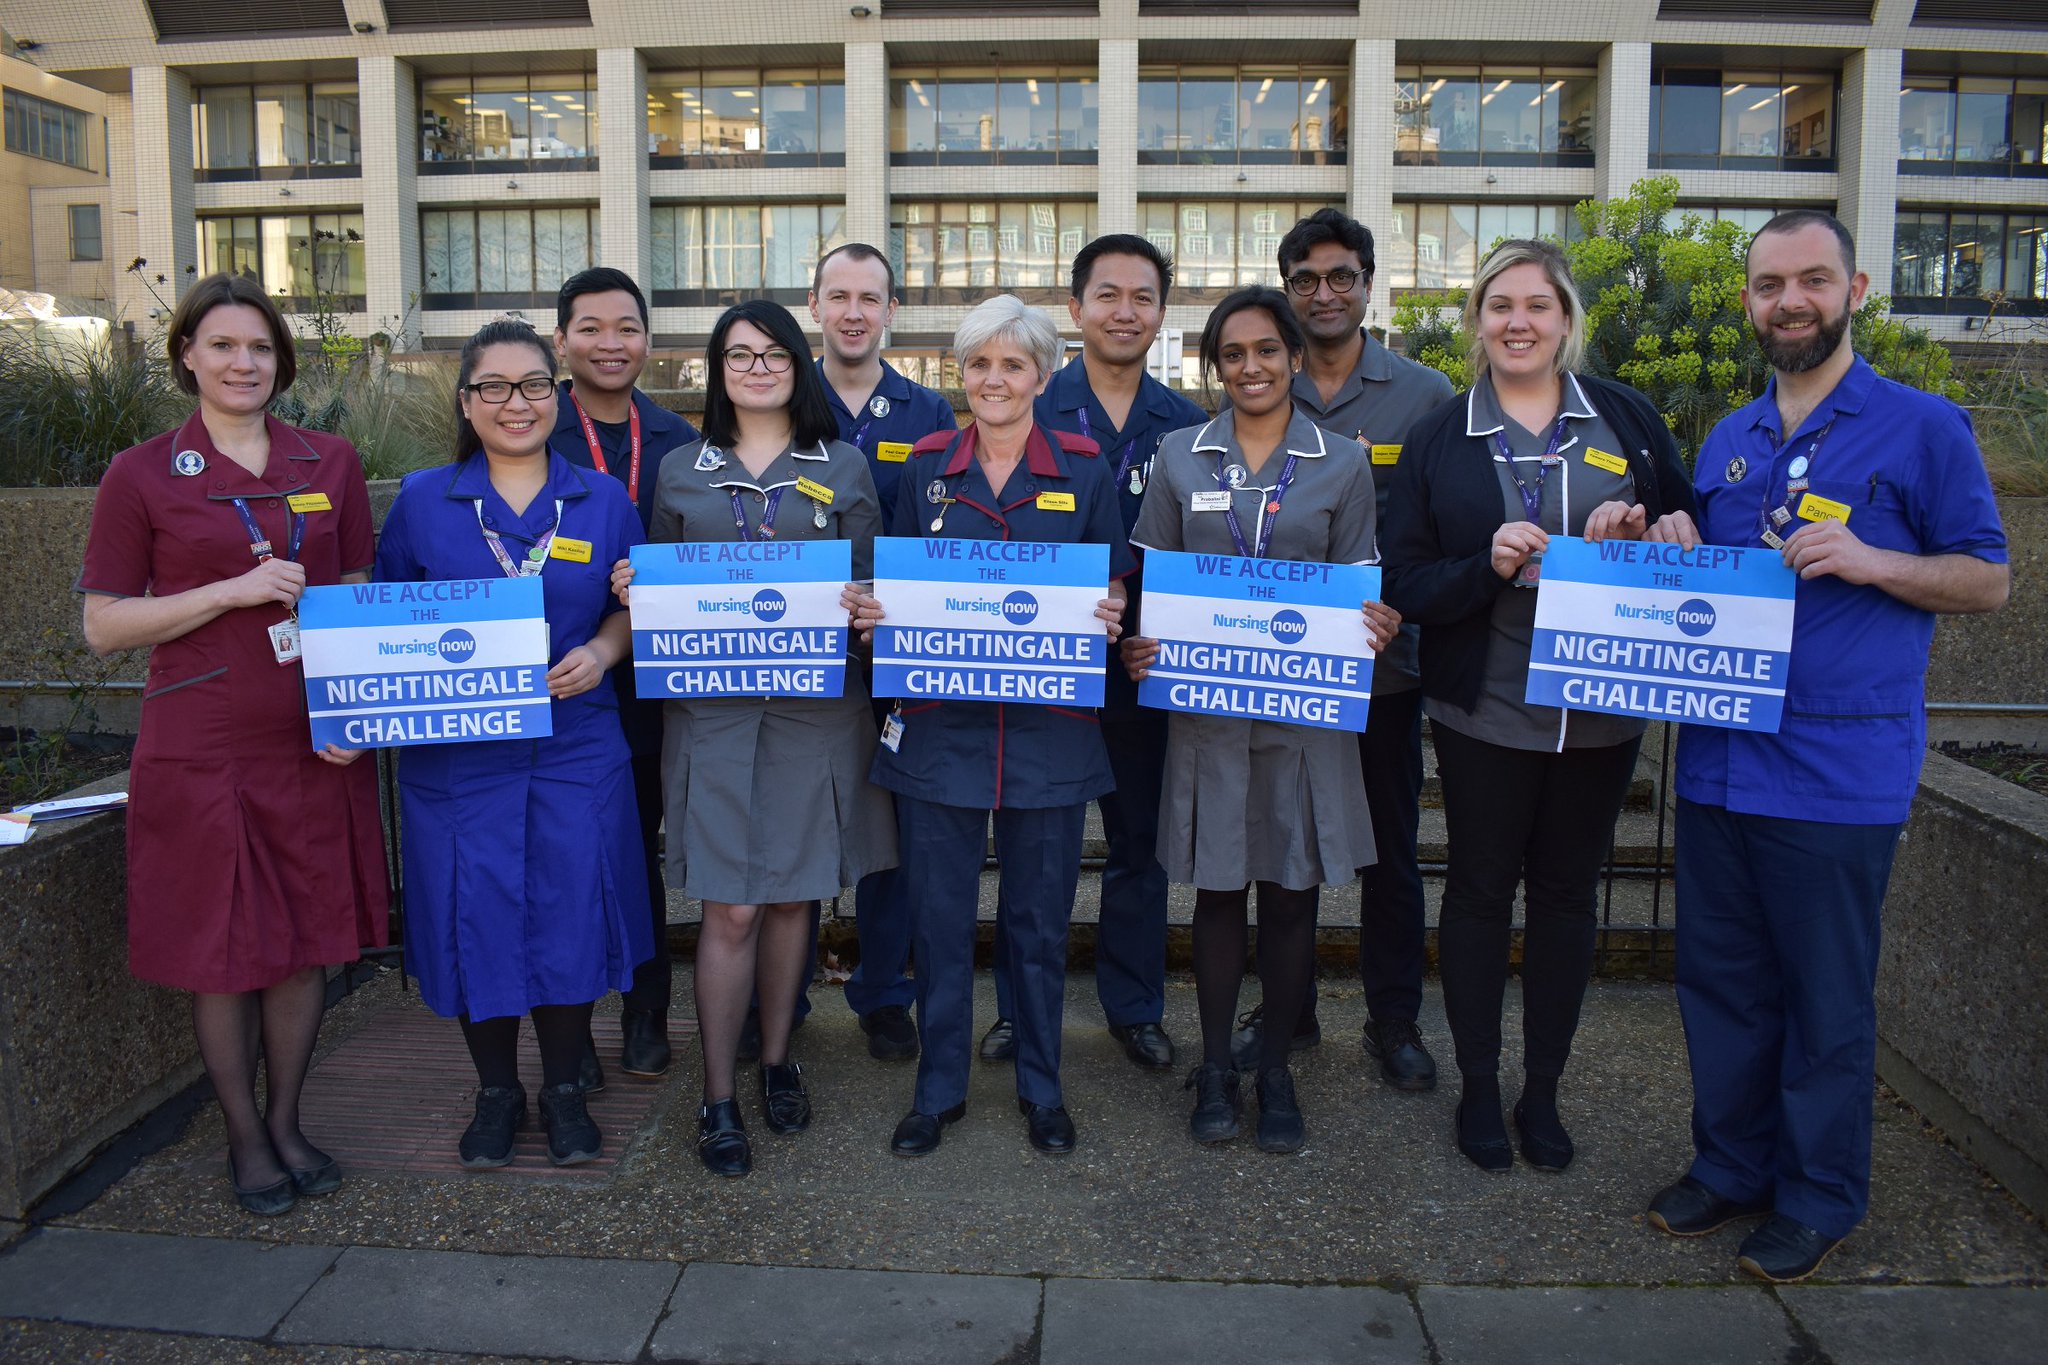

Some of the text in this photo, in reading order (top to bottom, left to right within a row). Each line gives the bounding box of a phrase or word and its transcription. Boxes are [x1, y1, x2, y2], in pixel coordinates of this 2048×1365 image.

[798, 480, 833, 501] Rebecca
[674, 542, 806, 564] WE ACCEPT
[924, 540, 1062, 563] WE ACCEPT
[1600, 541, 1745, 571] WE ACCEPT
[726, 568, 754, 580] THE
[978, 568, 1006, 580] THE
[1195, 555, 1334, 584] WE ACCEPT
[1652, 572, 1683, 587] THE
[353, 580, 494, 604] WE ACCEPT
[1247, 584, 1276, 598] THE
[410, 608, 440, 622] THE
[698, 598, 786, 614] Nursing now
[945, 597, 1038, 616] Nursing now
[1614, 603, 1715, 625] Nursing now
[1213, 614, 1306, 634] Nursing now
[378, 639, 474, 656] Nursing now
[652, 630, 838, 656] NIGHTINGALE
[894, 630, 1091, 661] NIGHTINGALE
[1159, 643, 1358, 685] NIGHTINGALE
[1553, 634, 1772, 681] NIGHTINGALE
[326, 669, 534, 704] NIGHTINGALE
[666, 670, 825, 693] CHALLENGE
[906, 670, 1076, 700] CHALLENGE
[1170, 684, 1340, 724] CHALLENGE
[1562, 678, 1752, 724] CHALLENGE
[344, 710, 522, 744] CHALLENGE
